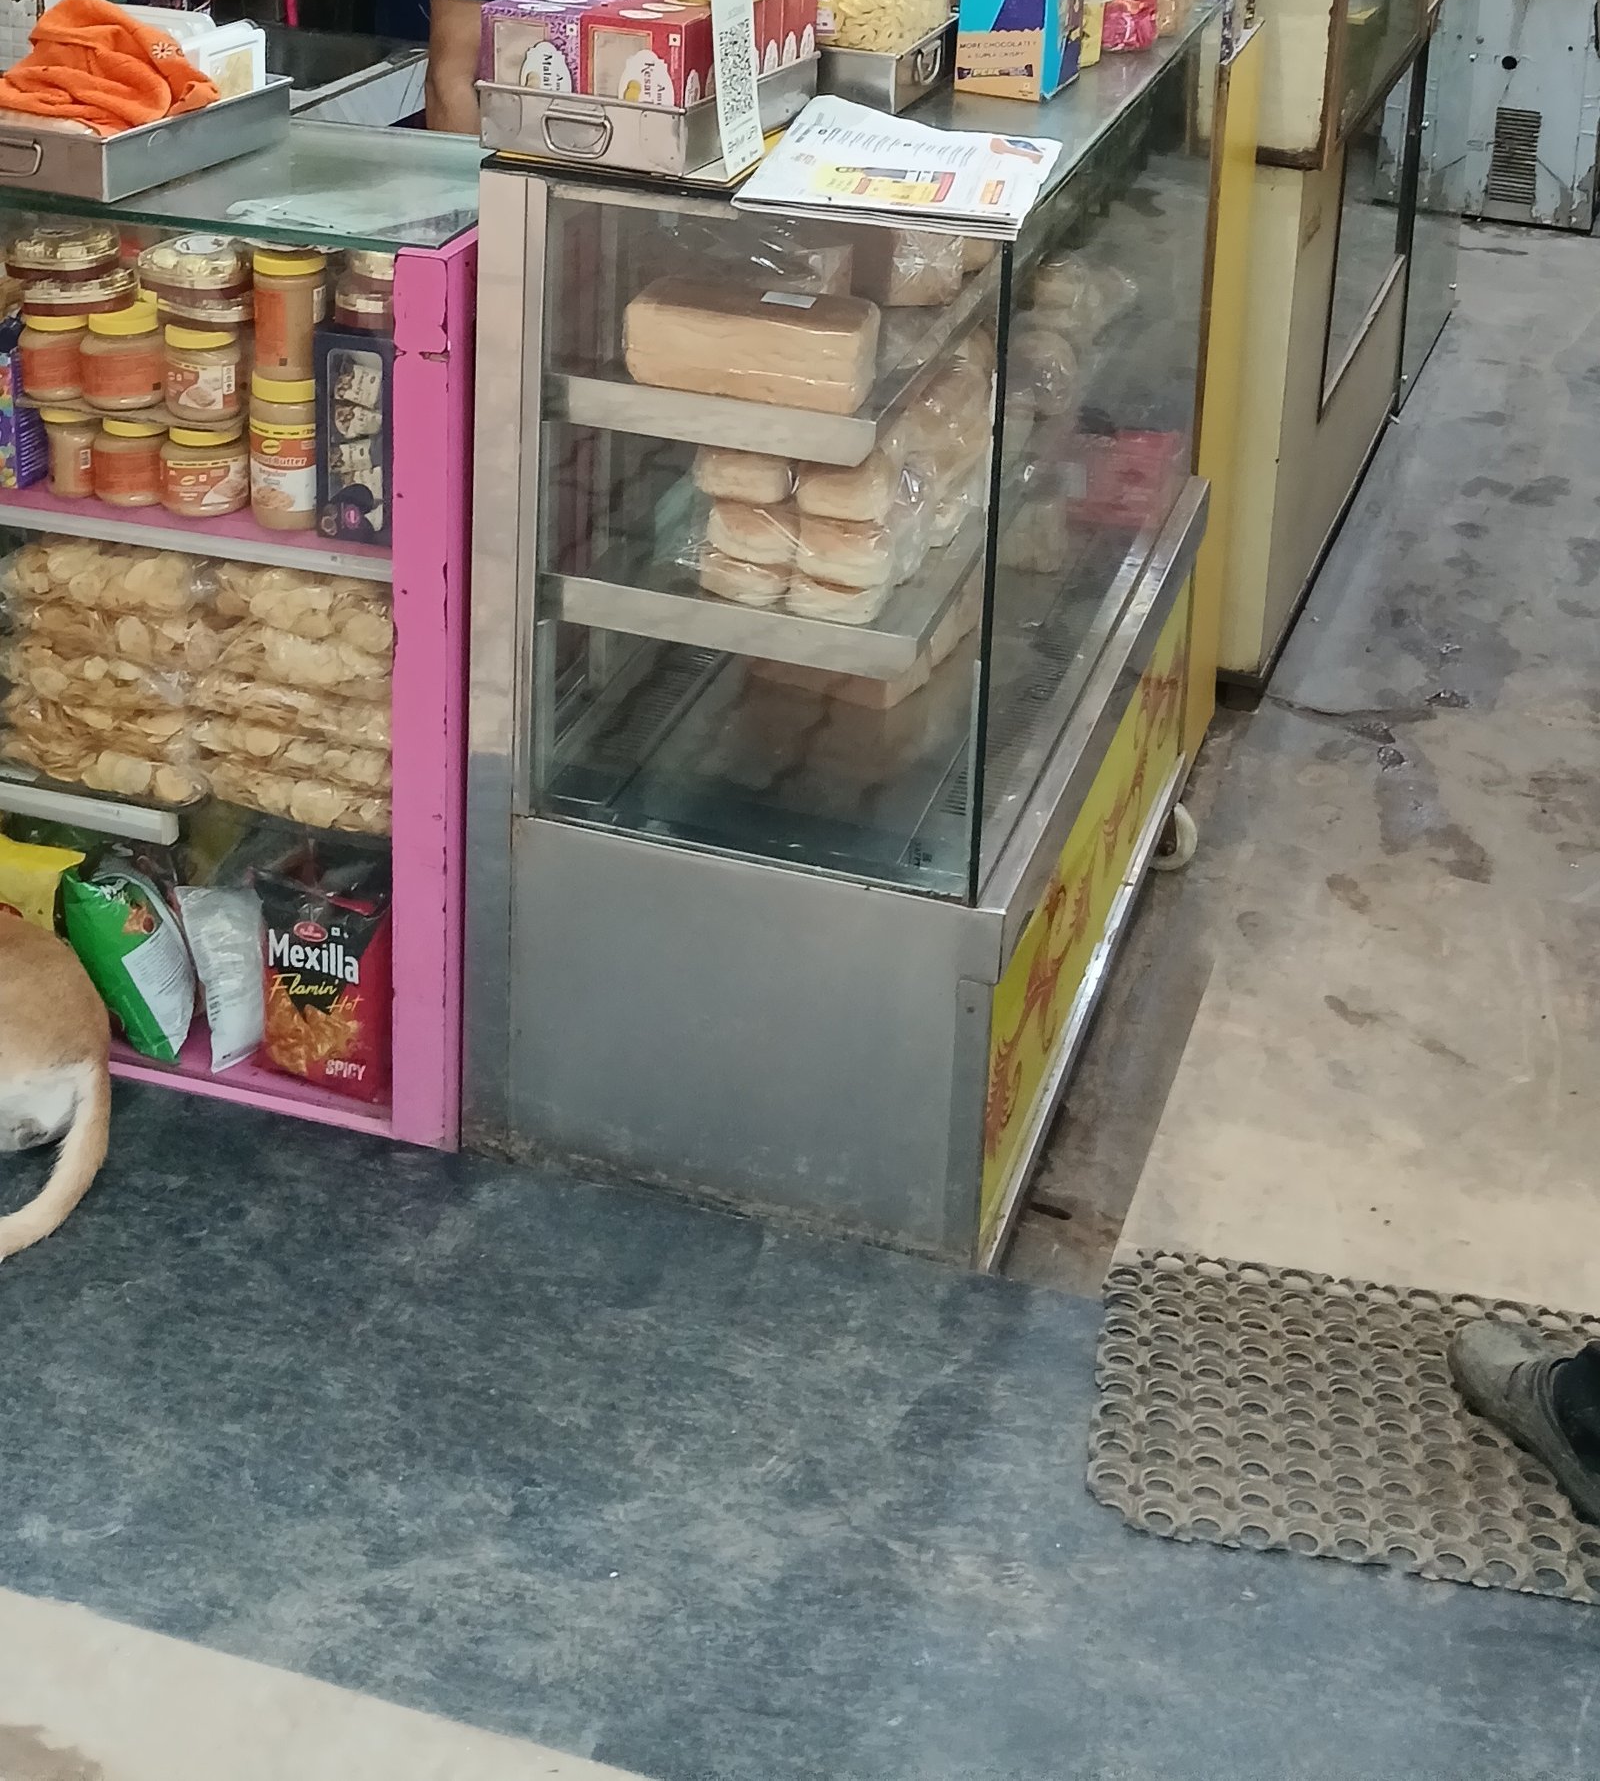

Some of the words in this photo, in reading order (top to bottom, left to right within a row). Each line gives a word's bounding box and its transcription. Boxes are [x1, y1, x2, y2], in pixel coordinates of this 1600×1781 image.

[543, 53, 553, 87] Malai
[640, 62, 655, 97] Kesar
[268, 928, 360, 985] Mexilla
[267, 972, 339, 1004] Flamin'
[325, 994, 365, 1014] Hot
[325, 1059, 367, 1082] SPICY
